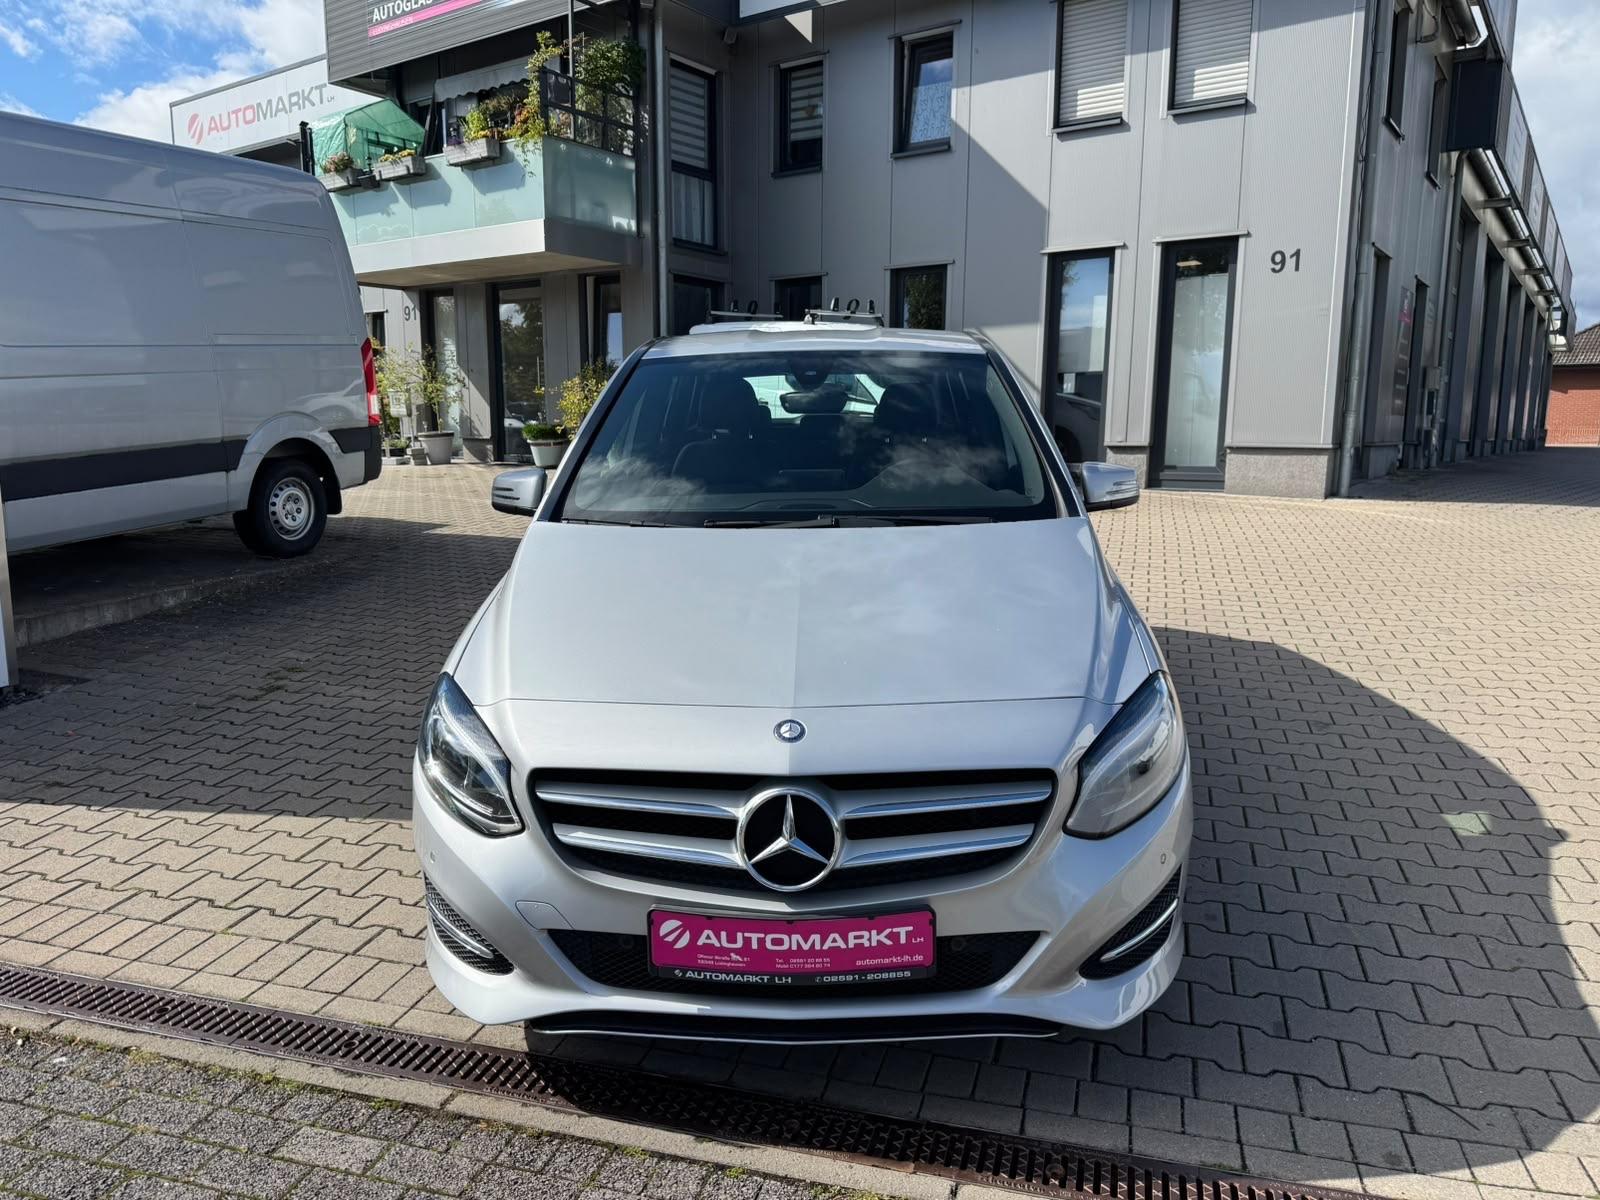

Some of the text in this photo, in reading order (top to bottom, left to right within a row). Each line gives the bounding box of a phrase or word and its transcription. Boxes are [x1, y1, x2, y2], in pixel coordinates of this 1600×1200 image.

[372, 0, 433, 22] AUTOGLA
[207, 83, 327, 136] AUTOMARKT
[1270, 248, 1301, 273] 91
[404, 304, 417, 321] 91
[697, 926, 914, 951] AUTOMARKT
[855, 954, 924, 966] automarkt-lh.de
[685, 970, 770, 983] AUTOMARKT
